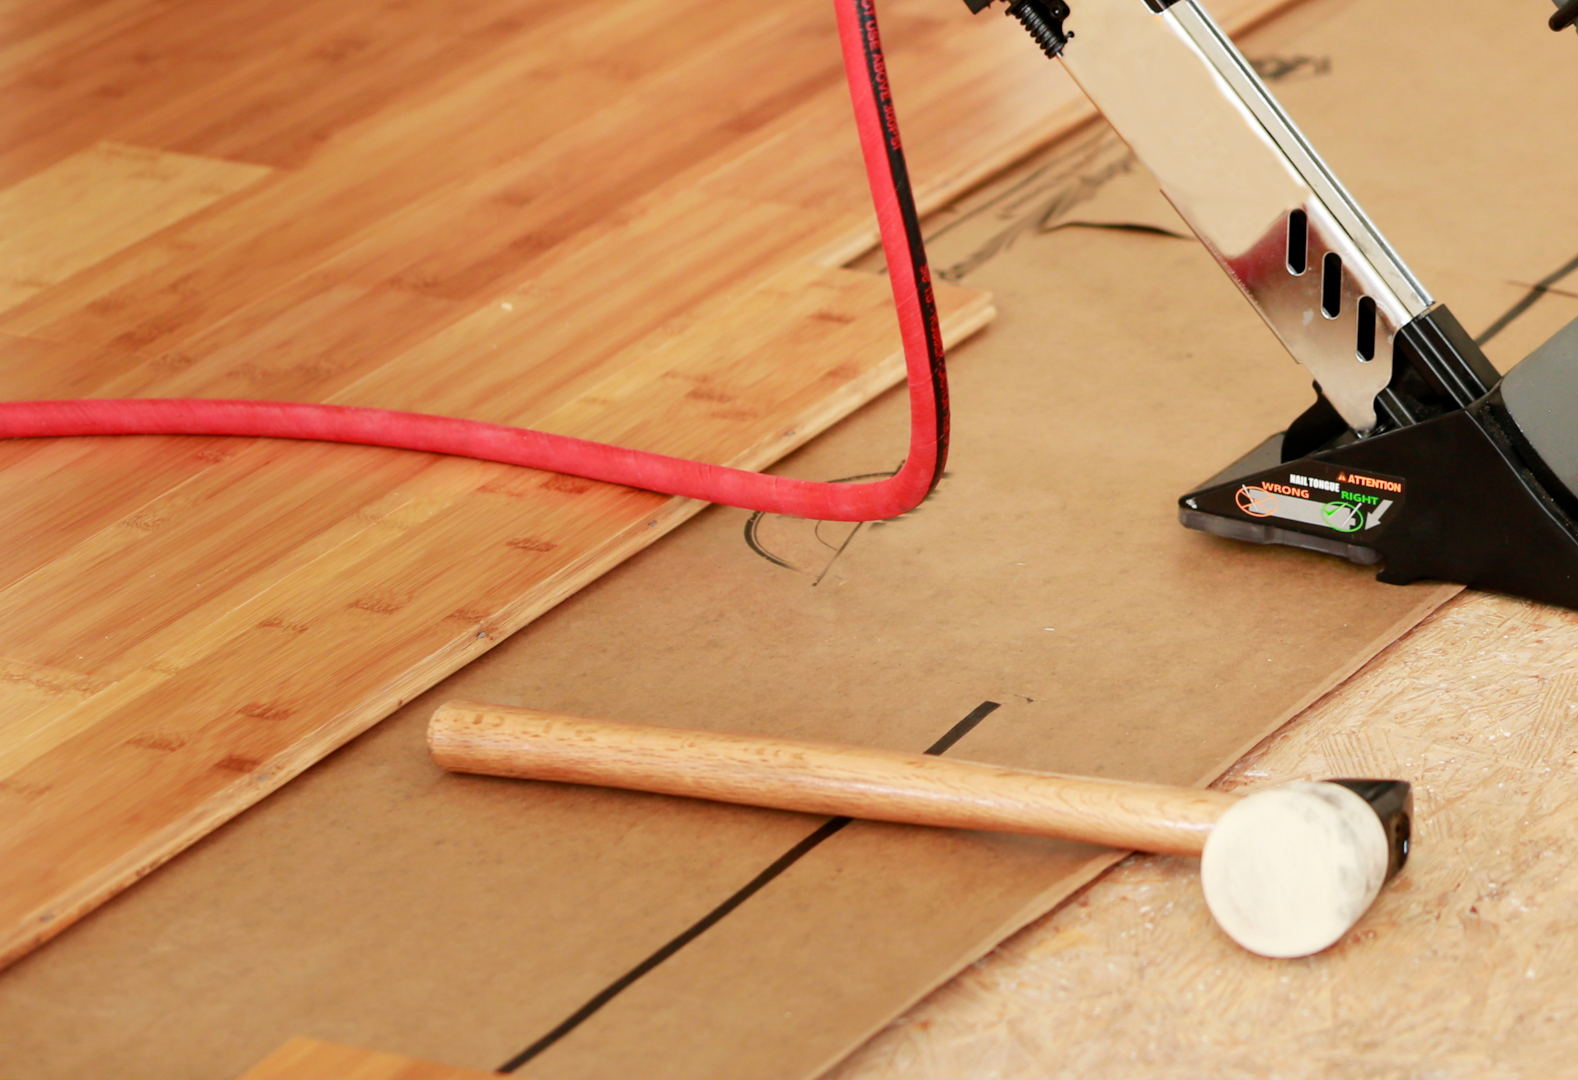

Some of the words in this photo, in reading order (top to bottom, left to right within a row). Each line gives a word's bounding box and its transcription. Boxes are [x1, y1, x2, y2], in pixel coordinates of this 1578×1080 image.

[865, 20, 880, 51] USE
[871, 53, 891, 102] ABOVE
[1261, 481, 1310, 498] WRONG
[1289, 473, 1309, 487] NAIL
[1308, 477, 1341, 493] TONGUE
[1348, 474, 1402, 493] ATTENTION
[1341, 490, 1379, 505] RIGHT
